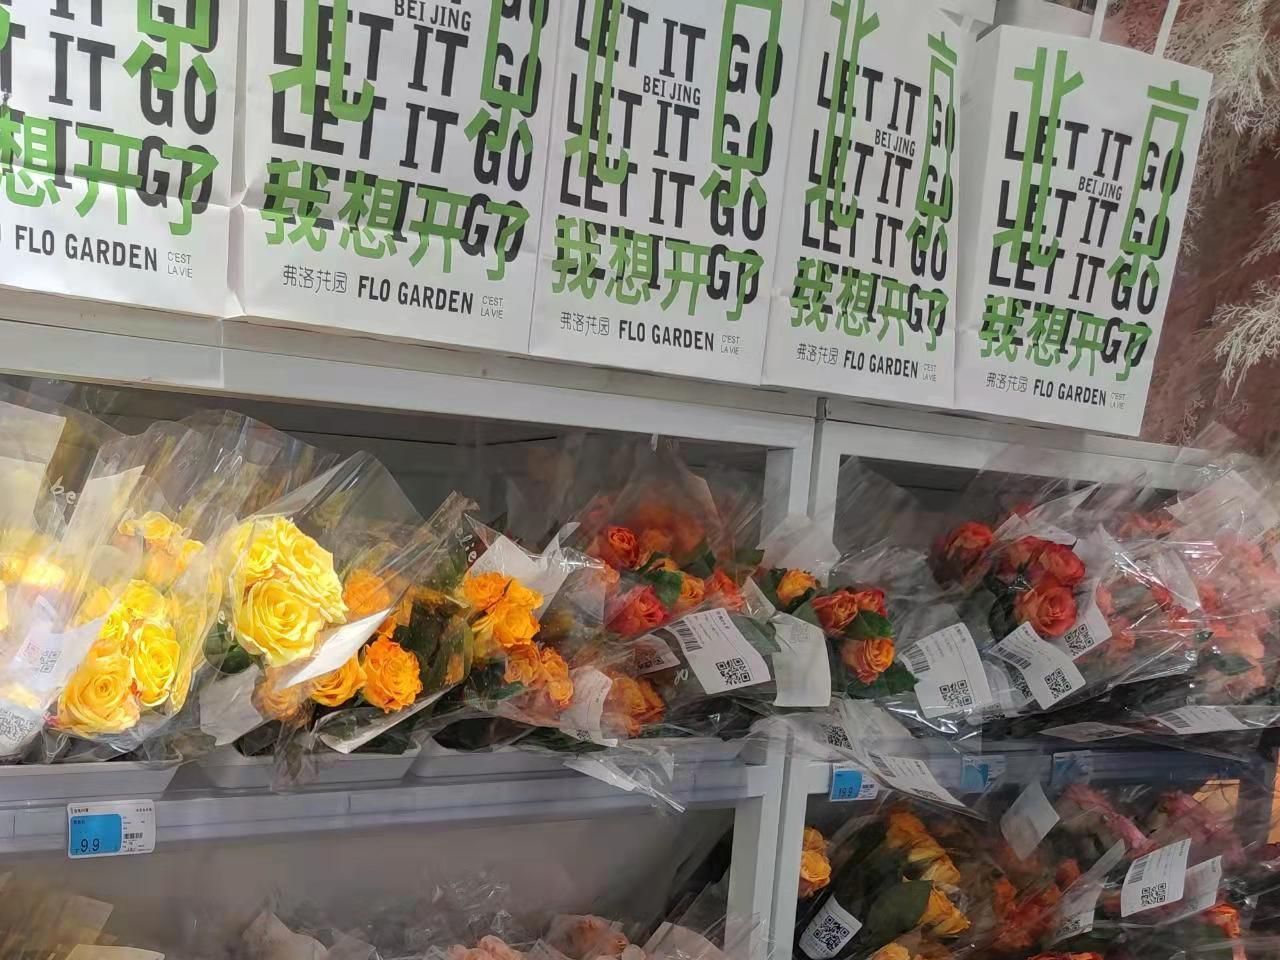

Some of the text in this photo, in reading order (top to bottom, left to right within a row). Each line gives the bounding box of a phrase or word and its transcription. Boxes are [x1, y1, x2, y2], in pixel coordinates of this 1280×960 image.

[408, 24, 469, 97] IT
[659, 18, 706, 82] IT
[49, 31, 115, 112] IT
[140, 53, 217, 135] GO
[887, 77, 921, 136] IT
[272, 82, 533, 192] LET IT GO
[653, 99, 699, 162] IT
[1093, 128, 1132, 181] IT
[560, 152, 767, 241] LET IT GO
[877, 151, 913, 208] IT
[15, 224, 158, 271] FLO GARDEN
[260, 160, 530, 281] 我想开了
[802, 200, 948, 281] LET IT GO
[1080, 196, 1119, 248] IT
[168, 251, 191, 265] C'EST
[168, 264, 193, 279] LA VIE
[283, 265, 347, 294] 弗洛花园
[552, 216, 764, 321] 我想开了
[988, 242, 1160, 315] LET IT GO
[358, 275, 473, 315] FLO GARDEN
[560, 311, 609, 336] 弗洛花园
[790, 258, 949, 351] 我想开了
[619, 320, 714, 351] FLO GARDEN
[796, 343, 839, 365] 弗洛花园
[978, 295, 1152, 381] 我想开了
[843, 350, 918, 379] FLO GARDEN
[1033, 379, 1106, 407] FLO GARDEN
[81, 838, 100, 853] 9.9
